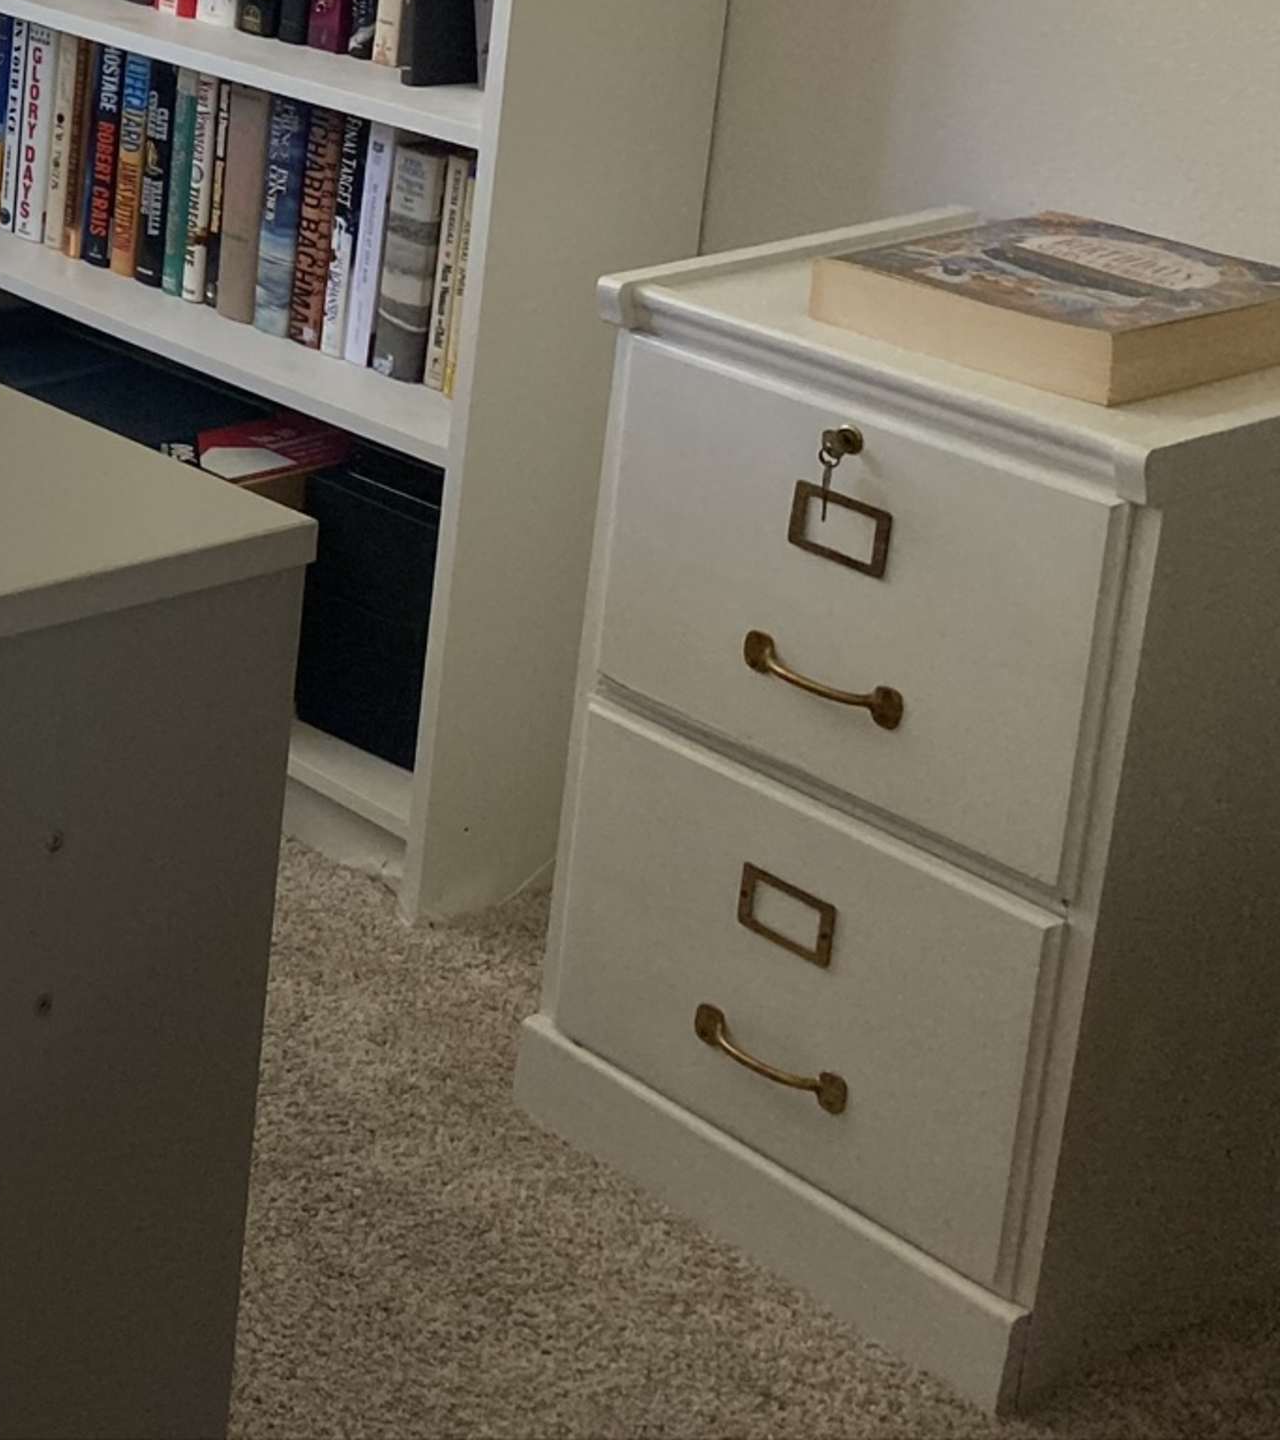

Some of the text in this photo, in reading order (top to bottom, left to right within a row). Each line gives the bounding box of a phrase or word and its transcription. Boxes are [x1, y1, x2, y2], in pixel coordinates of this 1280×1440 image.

[11, 43, 22, 90] YOUR
[27, 46, 43, 140] GLORY
[6, 94, 19, 135] FACE
[156, 107, 169, 141] CLIVE
[20, 146, 36, 219] DAYS
[96, 121, 116, 183] ROBERT
[336, 116, 363, 209] FINAL TARGET
[90, 184, 111, 237] CRAIS
[316, 162, 338, 295] REGULATORS
[290, 216, 322, 342] BACHMAN
